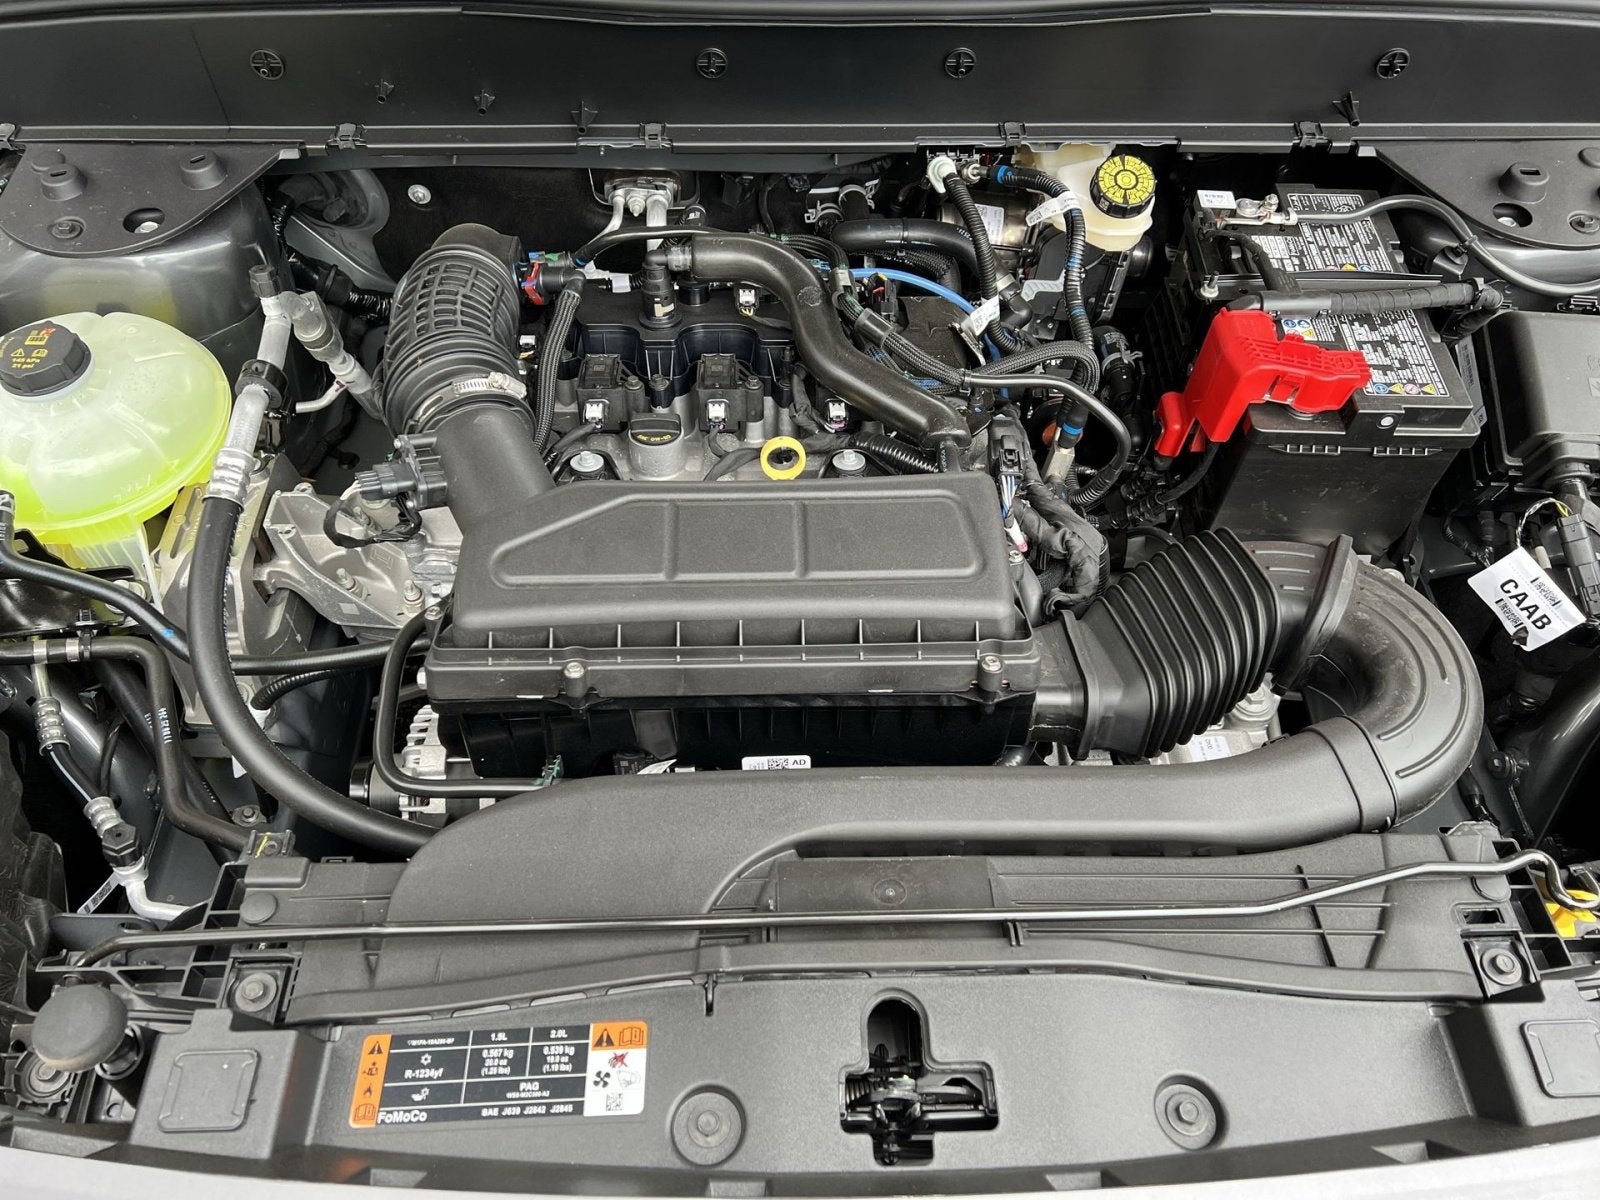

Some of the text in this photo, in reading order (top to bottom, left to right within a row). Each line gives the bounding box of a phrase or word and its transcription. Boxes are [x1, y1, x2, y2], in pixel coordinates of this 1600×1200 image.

[1500, 578, 1552, 630] CAAB
[490, 1032, 507, 1042] 1.5L
[550, 1029, 568, 1039] 2.0L
[404, 1068, 443, 1080] R-1234yf
[520, 1082, 540, 1092] PAG
[377, 1110, 427, 1124] FoMoCo
[482, 1106, 499, 1117] SAE
